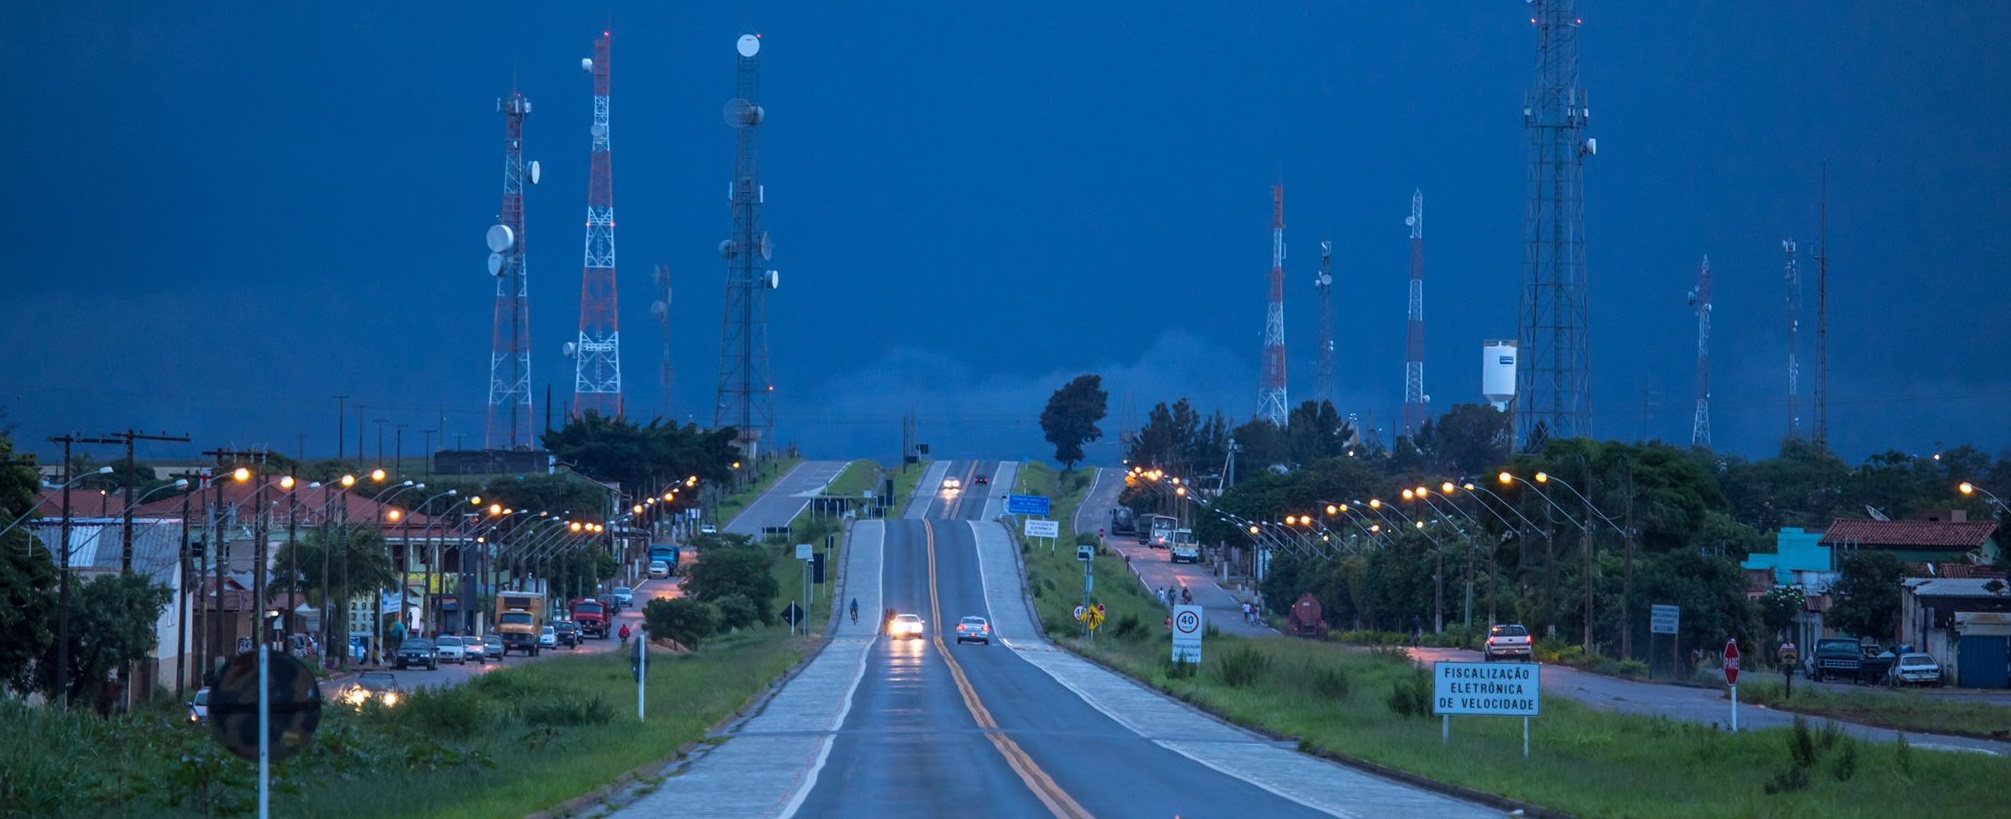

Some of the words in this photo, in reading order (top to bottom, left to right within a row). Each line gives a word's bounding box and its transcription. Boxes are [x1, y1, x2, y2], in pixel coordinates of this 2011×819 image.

[1181, 616, 1194, 624] 40
[1724, 657, 1739, 670] PARE
[1444, 667, 1530, 680] FISCALIZAÇÃO
[1451, 682, 1522, 694] ELETRÔNICA
[1440, 698, 1454, 708] DE
[1462, 698, 1534, 710] VELOCIDADE
